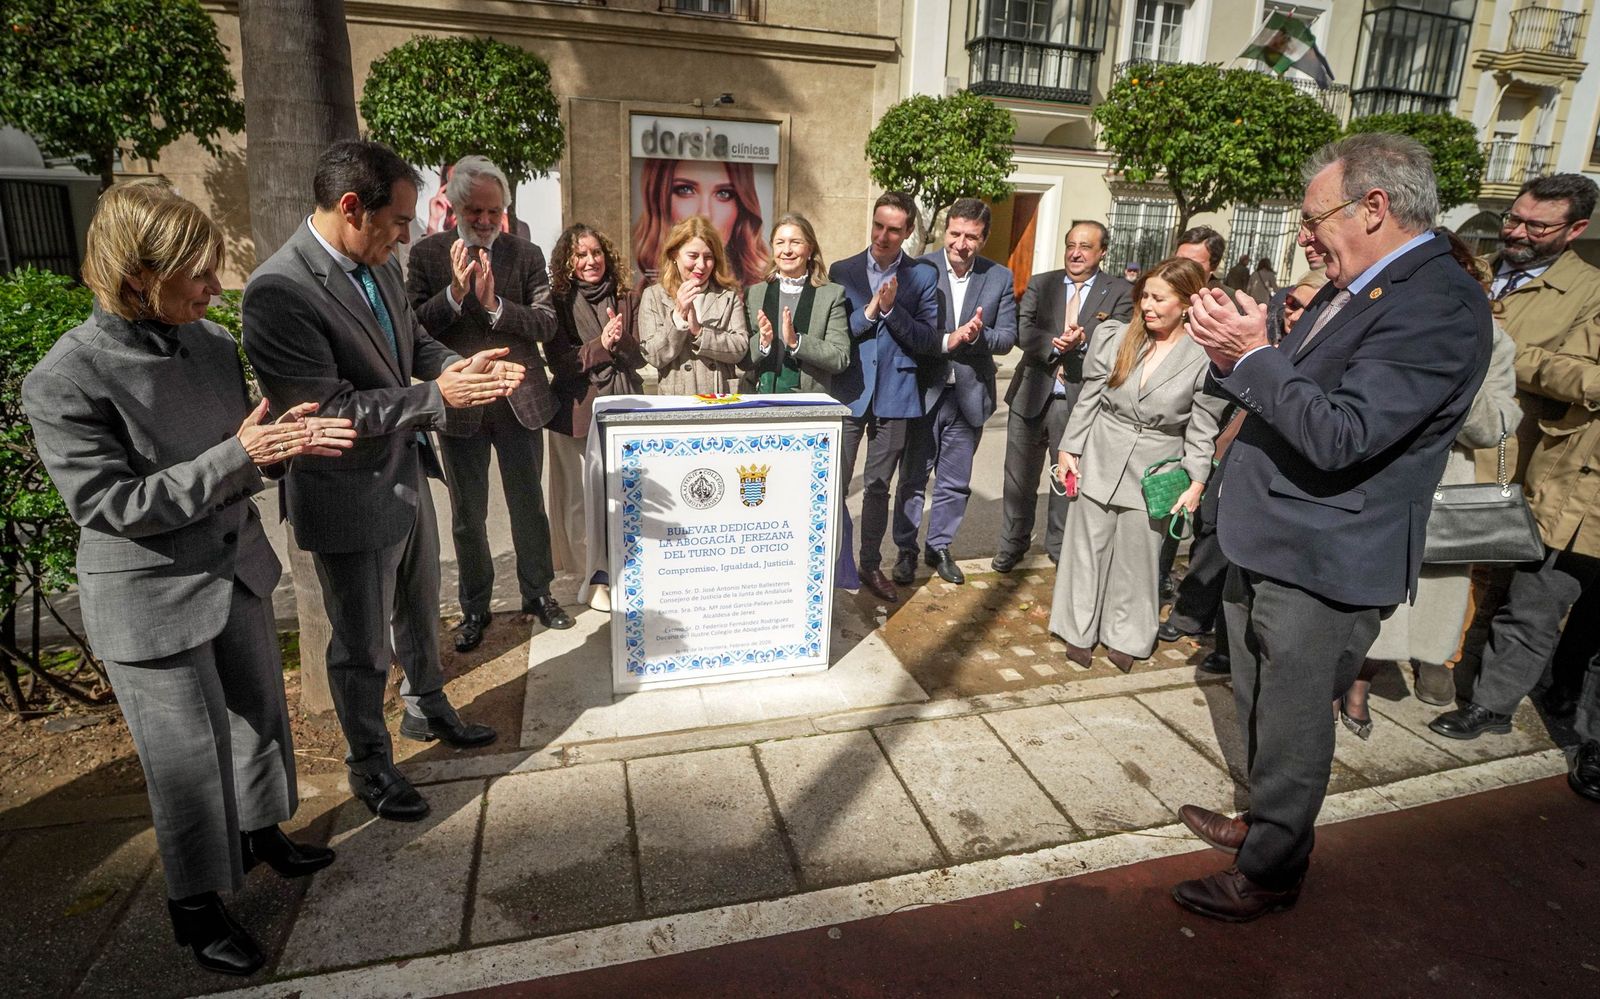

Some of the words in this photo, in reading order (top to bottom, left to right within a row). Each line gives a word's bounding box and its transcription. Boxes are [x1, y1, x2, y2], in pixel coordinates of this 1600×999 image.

[642, 120, 728, 158] dorsia
[732, 142, 770, 155] clínicas
[667, 525, 717, 536] BULEVAR
[720, 521, 779, 533] DEDICADO
[782, 520, 790, 529] A
[676, 535, 736, 547] ABOGACÍA
[741, 531, 794, 544] JEREZANA
[664, 551, 686, 560] DEL
[688, 548, 726, 558] TURNO
[731, 546, 746, 555] DE
[751, 543, 789, 554] OFICIO
[658, 565, 718, 576] Compromiso,
[721, 561, 761, 573] Igualdad,
[763, 559, 796, 569] Justicia.
